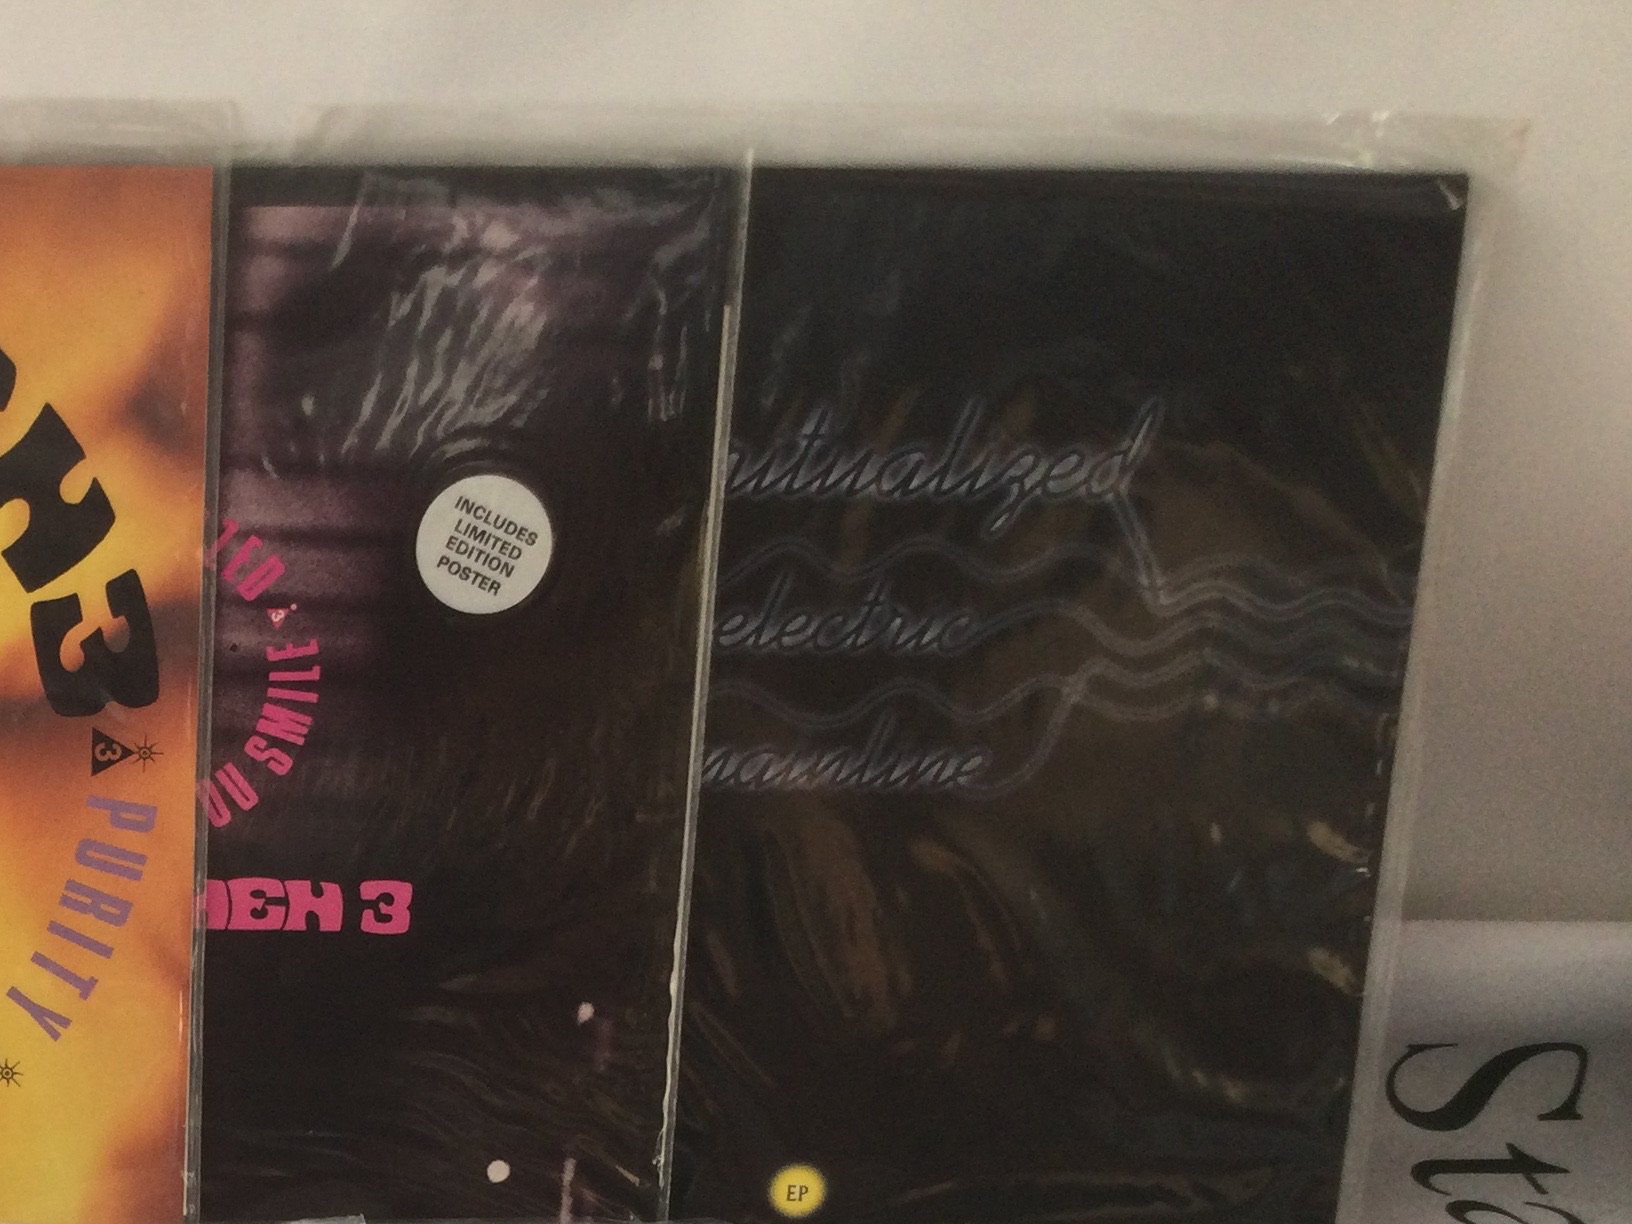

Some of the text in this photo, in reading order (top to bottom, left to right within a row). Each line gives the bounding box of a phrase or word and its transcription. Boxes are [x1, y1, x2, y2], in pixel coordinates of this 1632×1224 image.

[454, 495, 538, 547] INCLUDES
[454, 518, 522, 560] LIMITED
[437, 555, 501, 596] POSTER
[445, 535, 515, 578] EDITION
[244, 638, 321, 777] SMILE
[7, 795, 157, 1041] PURITY
[360, 878, 413, 935] 3
[786, 1184, 809, 1202] EP
